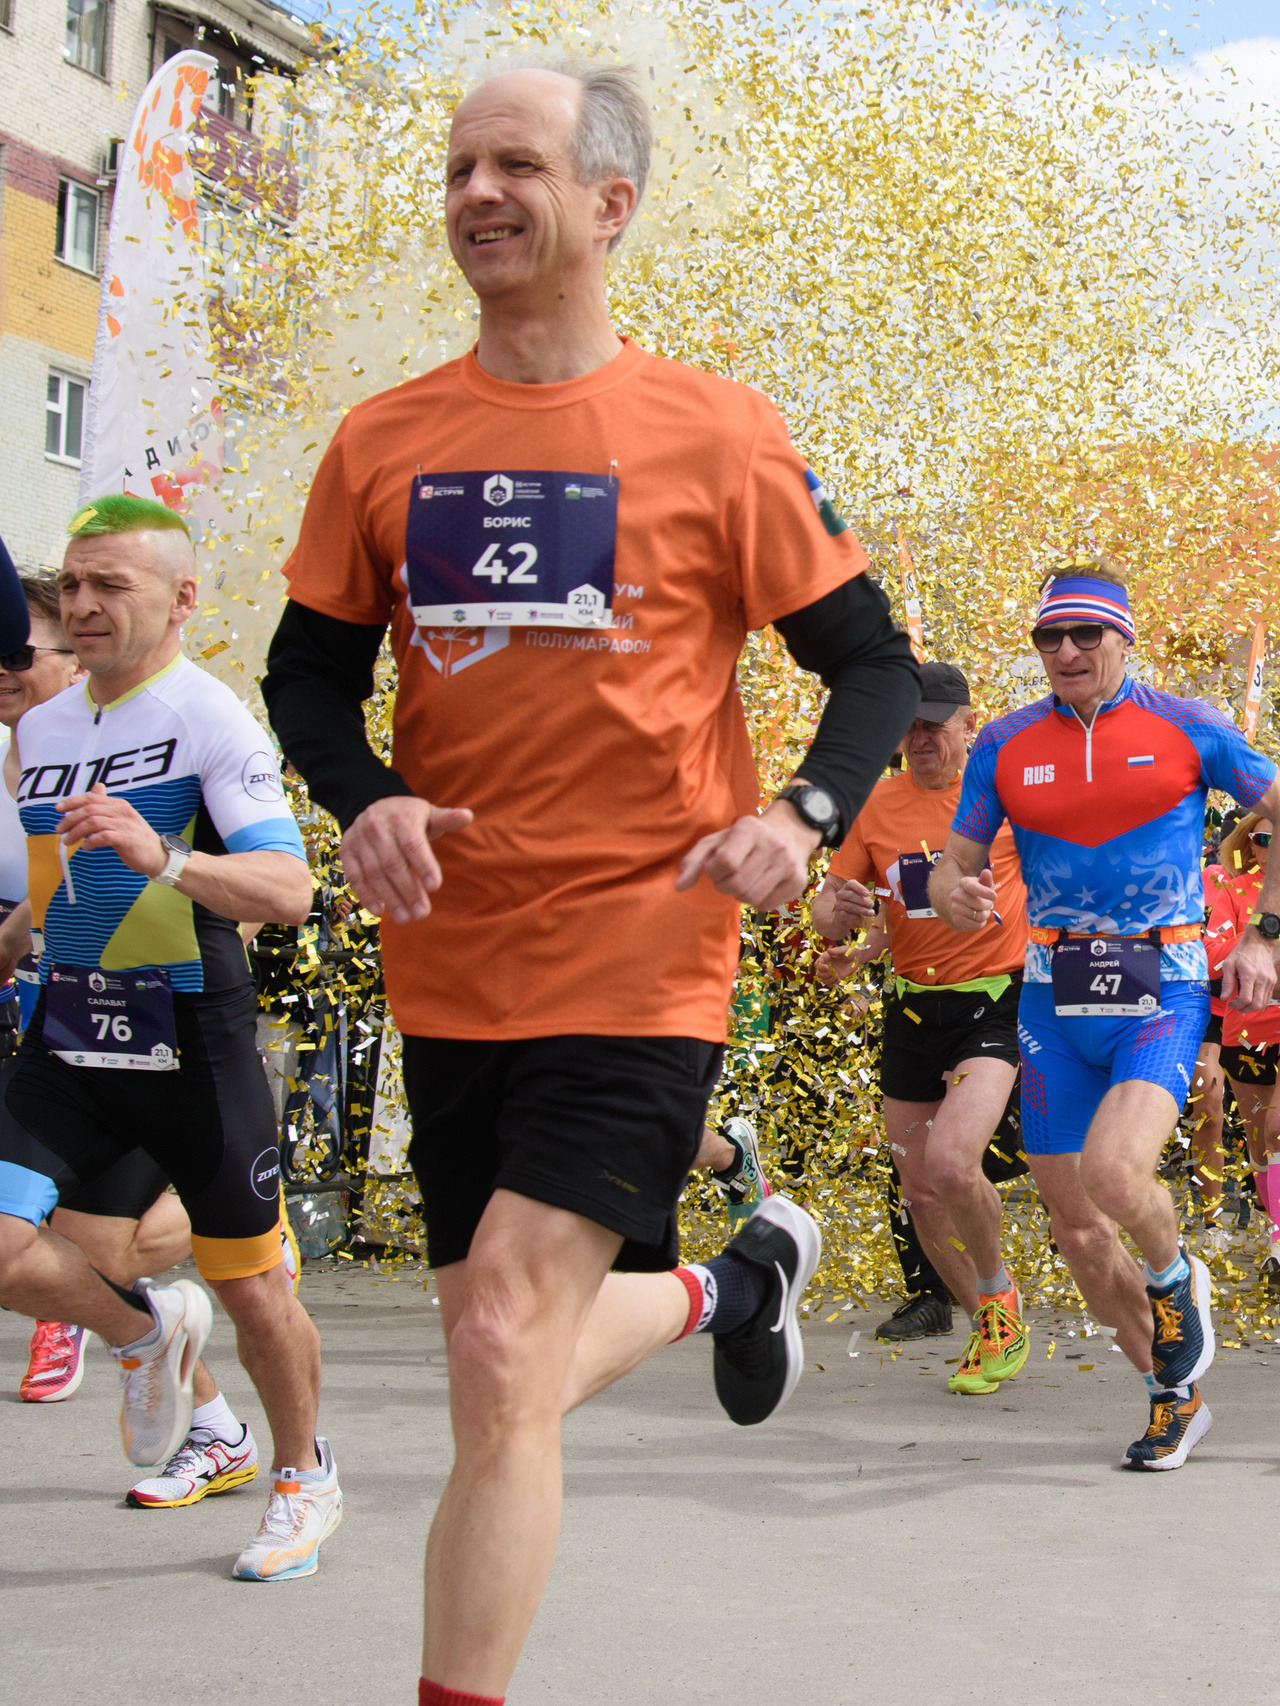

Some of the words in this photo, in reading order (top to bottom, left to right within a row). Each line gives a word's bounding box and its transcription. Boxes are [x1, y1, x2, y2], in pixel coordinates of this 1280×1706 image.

[483, 516, 531, 529] БОРИС
[472, 542, 538, 584] 42
[574, 594, 598, 607] 21,1
[525, 631, 653, 654] ПОЛУМАРАФОН
[1023, 764, 1055, 786] RUS
[1089, 959, 1120, 968] АНДРЕЙ
[1089, 974, 1122, 996] 47
[87, 997, 127, 1008] САЛАВАТ
[91, 1013, 133, 1042] 76
[155, 1049, 169, 1058] 21,1
